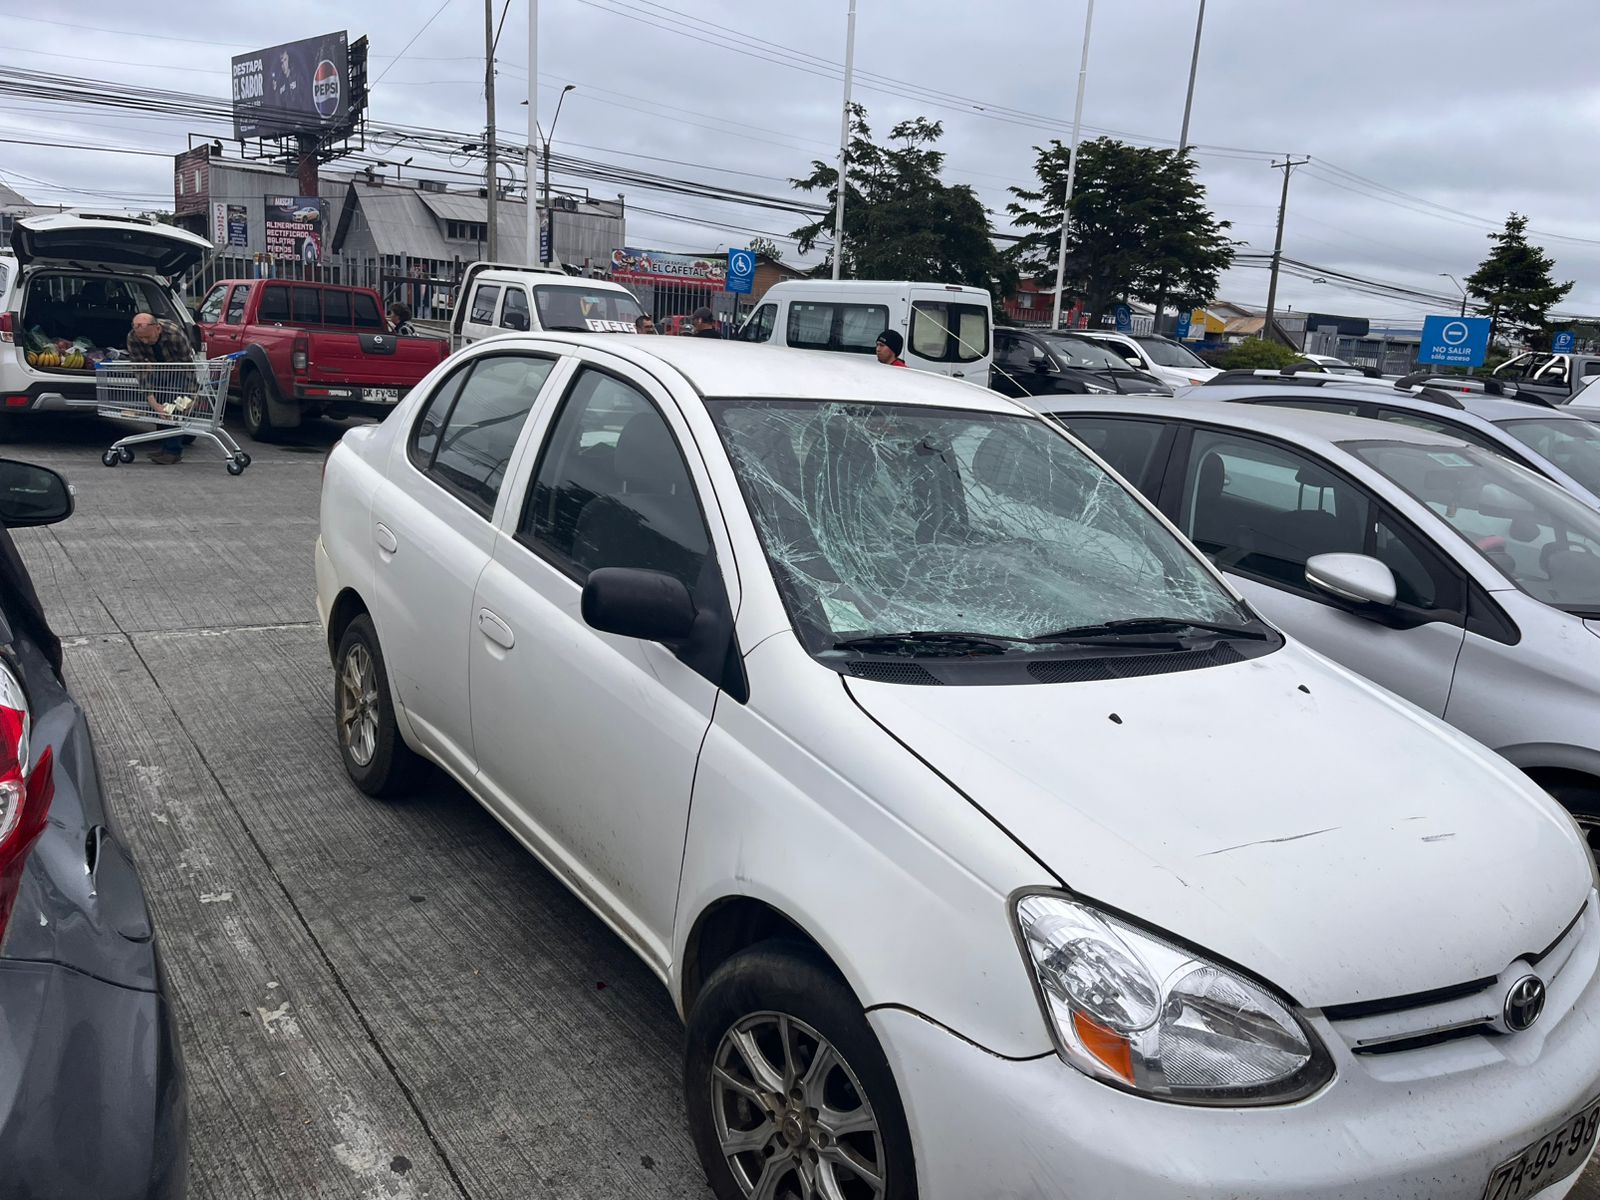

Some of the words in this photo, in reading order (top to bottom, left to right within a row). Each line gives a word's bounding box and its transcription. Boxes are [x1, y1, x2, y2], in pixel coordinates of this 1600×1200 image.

[233, 59, 263, 77] DESTAPA
[234, 78, 241, 101] EL
[241, 73, 264, 99] SABOR
[314, 82, 338, 96] PEPSI
[266, 221, 314, 231] ALINEAMIENTO
[266, 229, 309, 238] RECTIFICADO
[267, 237, 295, 246] BALATAS
[652, 263, 663, 273] EL
[664, 264, 704, 277] CAFETAL
[590, 320, 637, 332] FLETE
[1432, 346, 1446, 354] NO
[1447, 347, 1471, 355] SALIR
